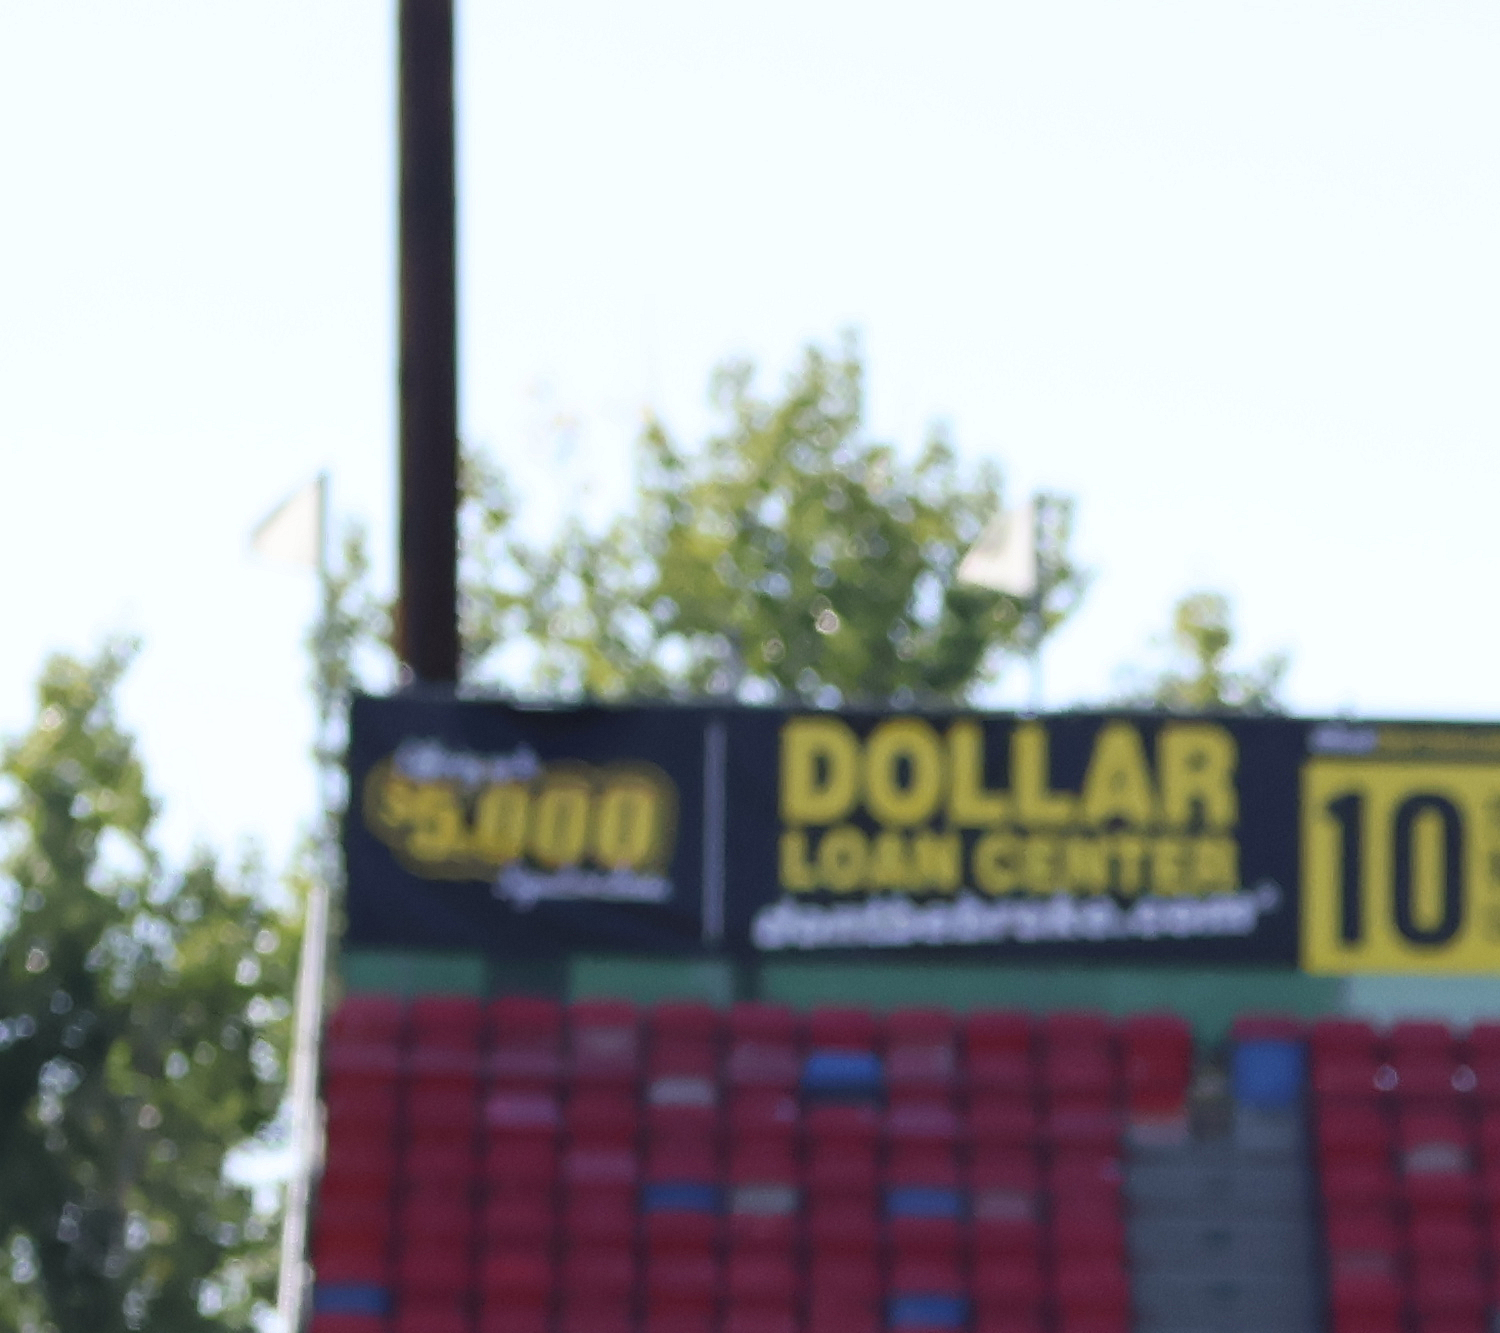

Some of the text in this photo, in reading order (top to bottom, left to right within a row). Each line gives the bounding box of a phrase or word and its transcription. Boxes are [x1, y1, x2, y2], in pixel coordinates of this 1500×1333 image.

[780, 715, 1240, 830] DOLLAR
[780, 827, 1240, 896] LOAN CENTER
[1323, 792, 1466, 949] 10
